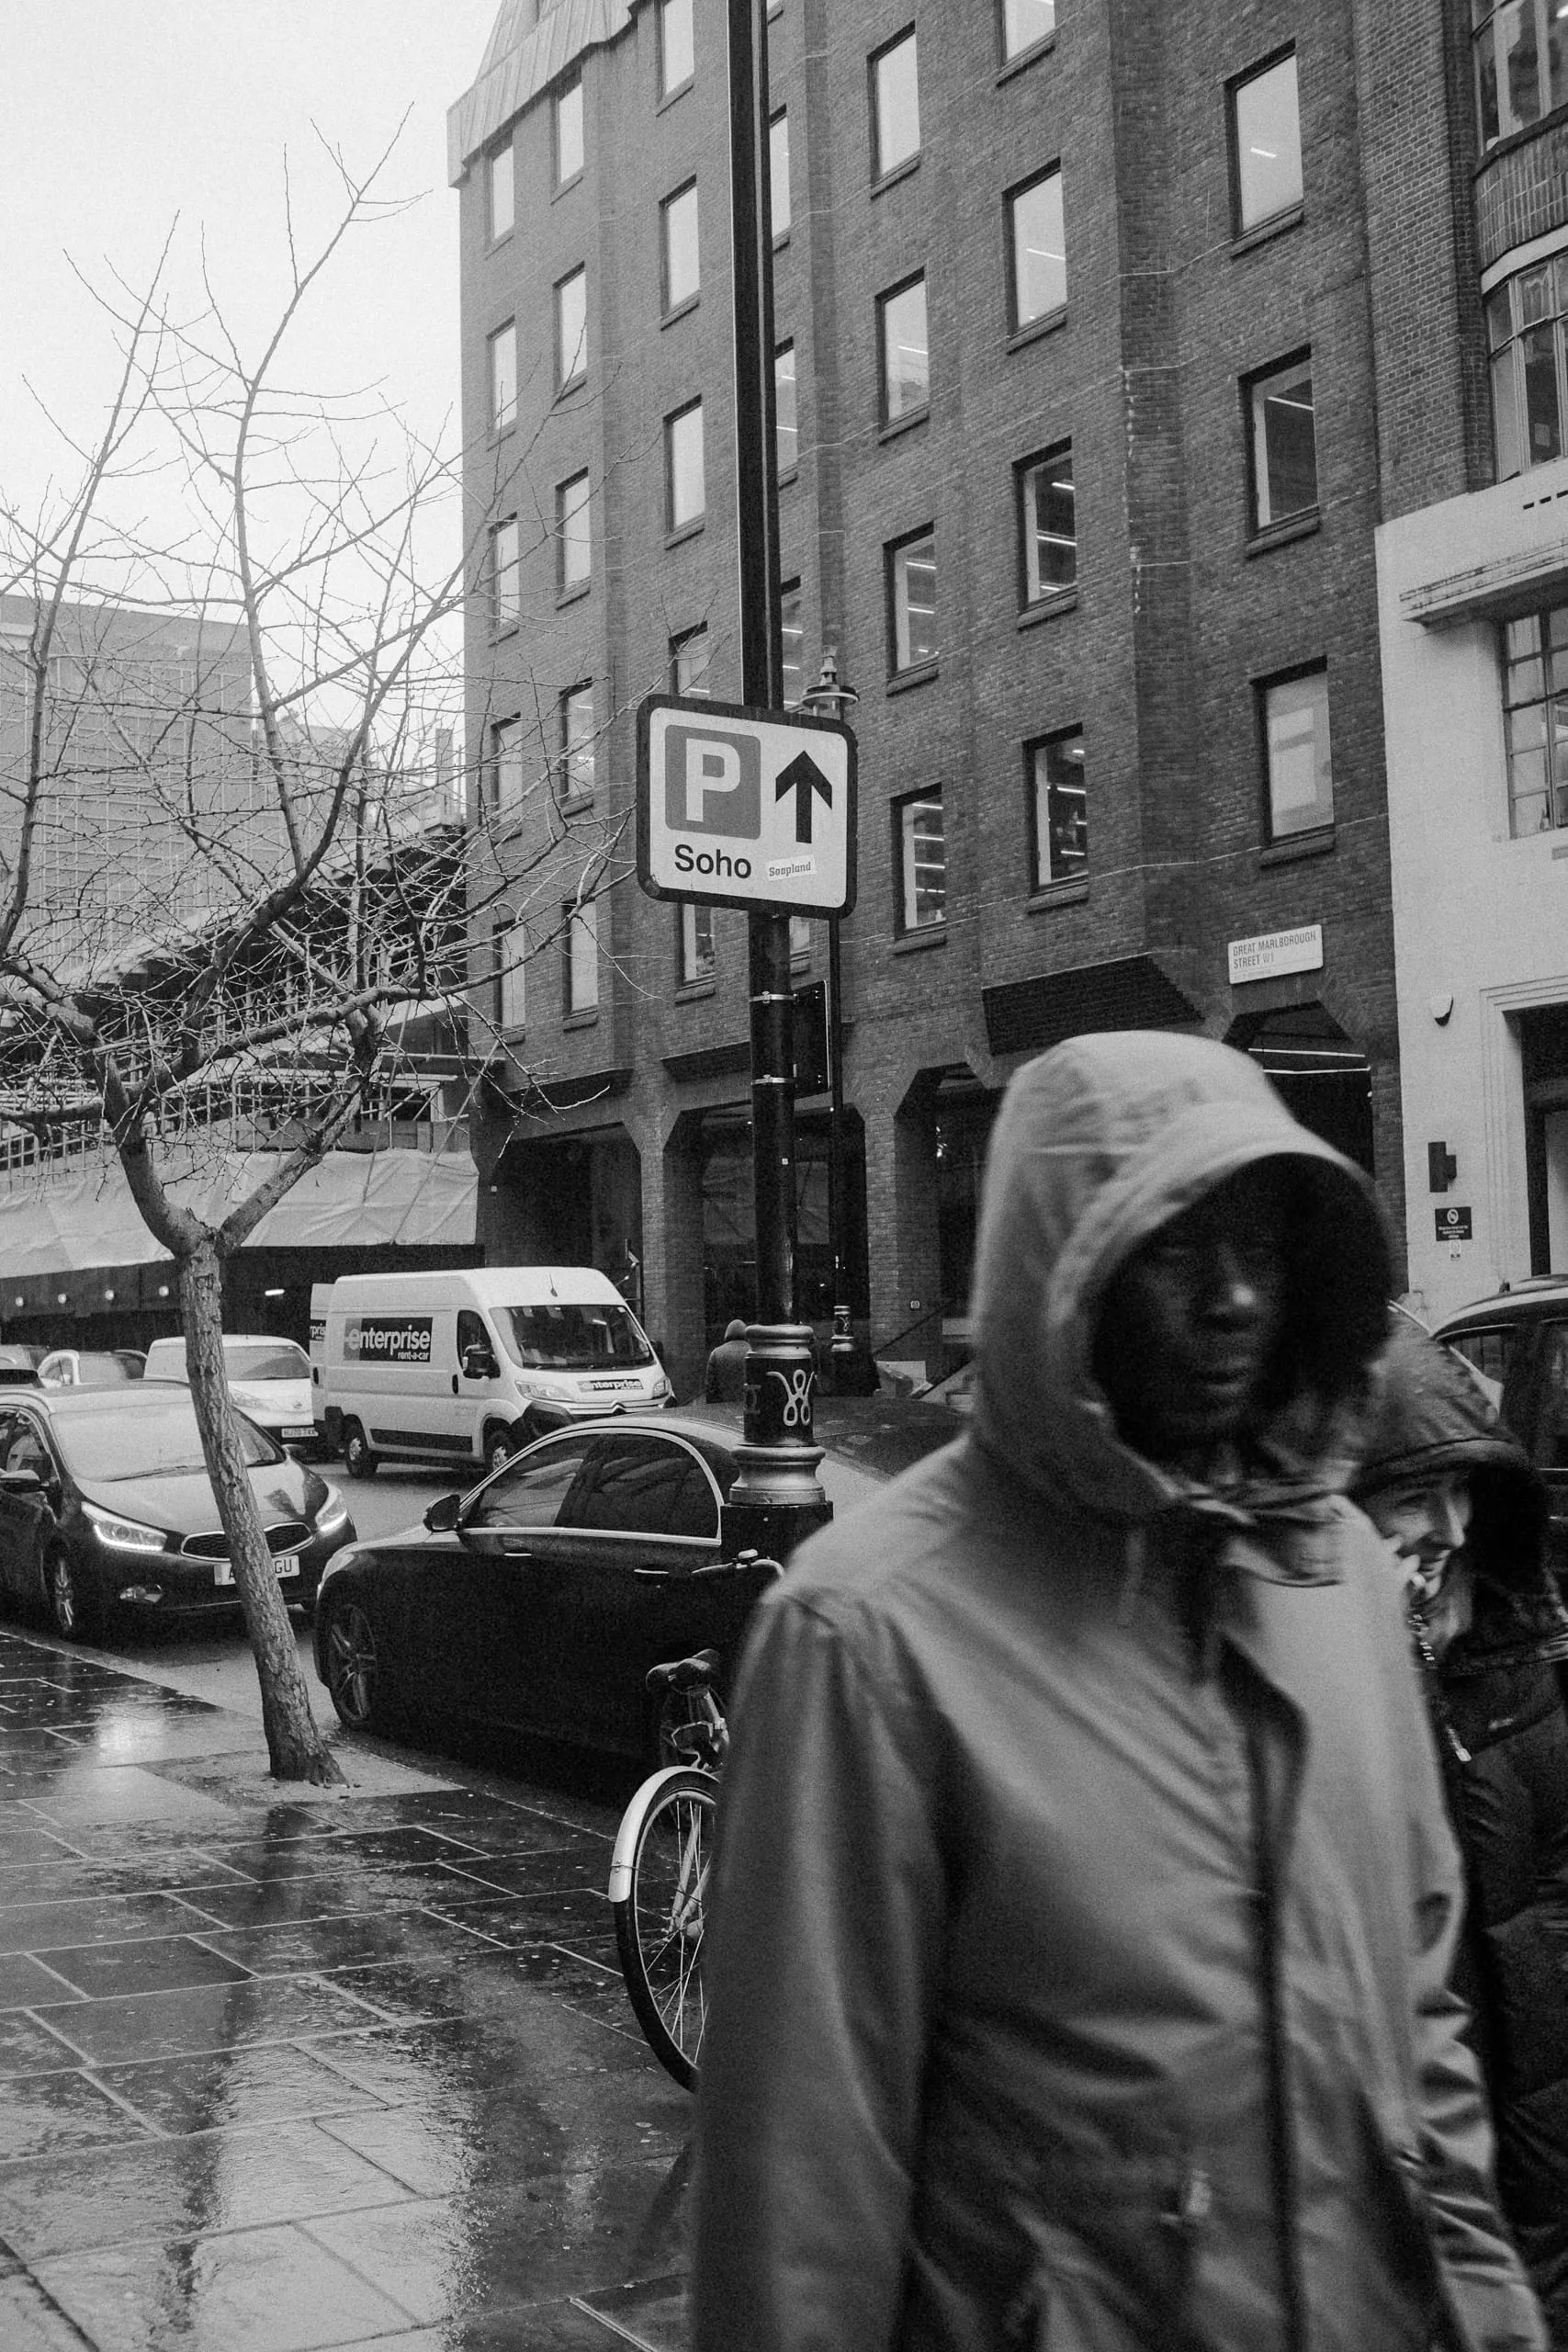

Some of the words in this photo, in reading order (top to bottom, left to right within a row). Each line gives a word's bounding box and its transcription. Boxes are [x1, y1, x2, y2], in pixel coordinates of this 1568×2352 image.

[686, 738, 740, 822] P
[674, 843, 751, 879] Soho
[769, 861, 811, 876] Soapland
[1233, 942, 1257, 956] GREAT
[1258, 931, 1316, 952] MARLBOROUGH
[1233, 955, 1260, 969] STREET
[1262, 951, 1275, 964] W1
[348, 1324, 431, 1356] enterprise
[397, 1351, 429, 1360] rent-a-car
[583, 1379, 642, 1389] enterprise
